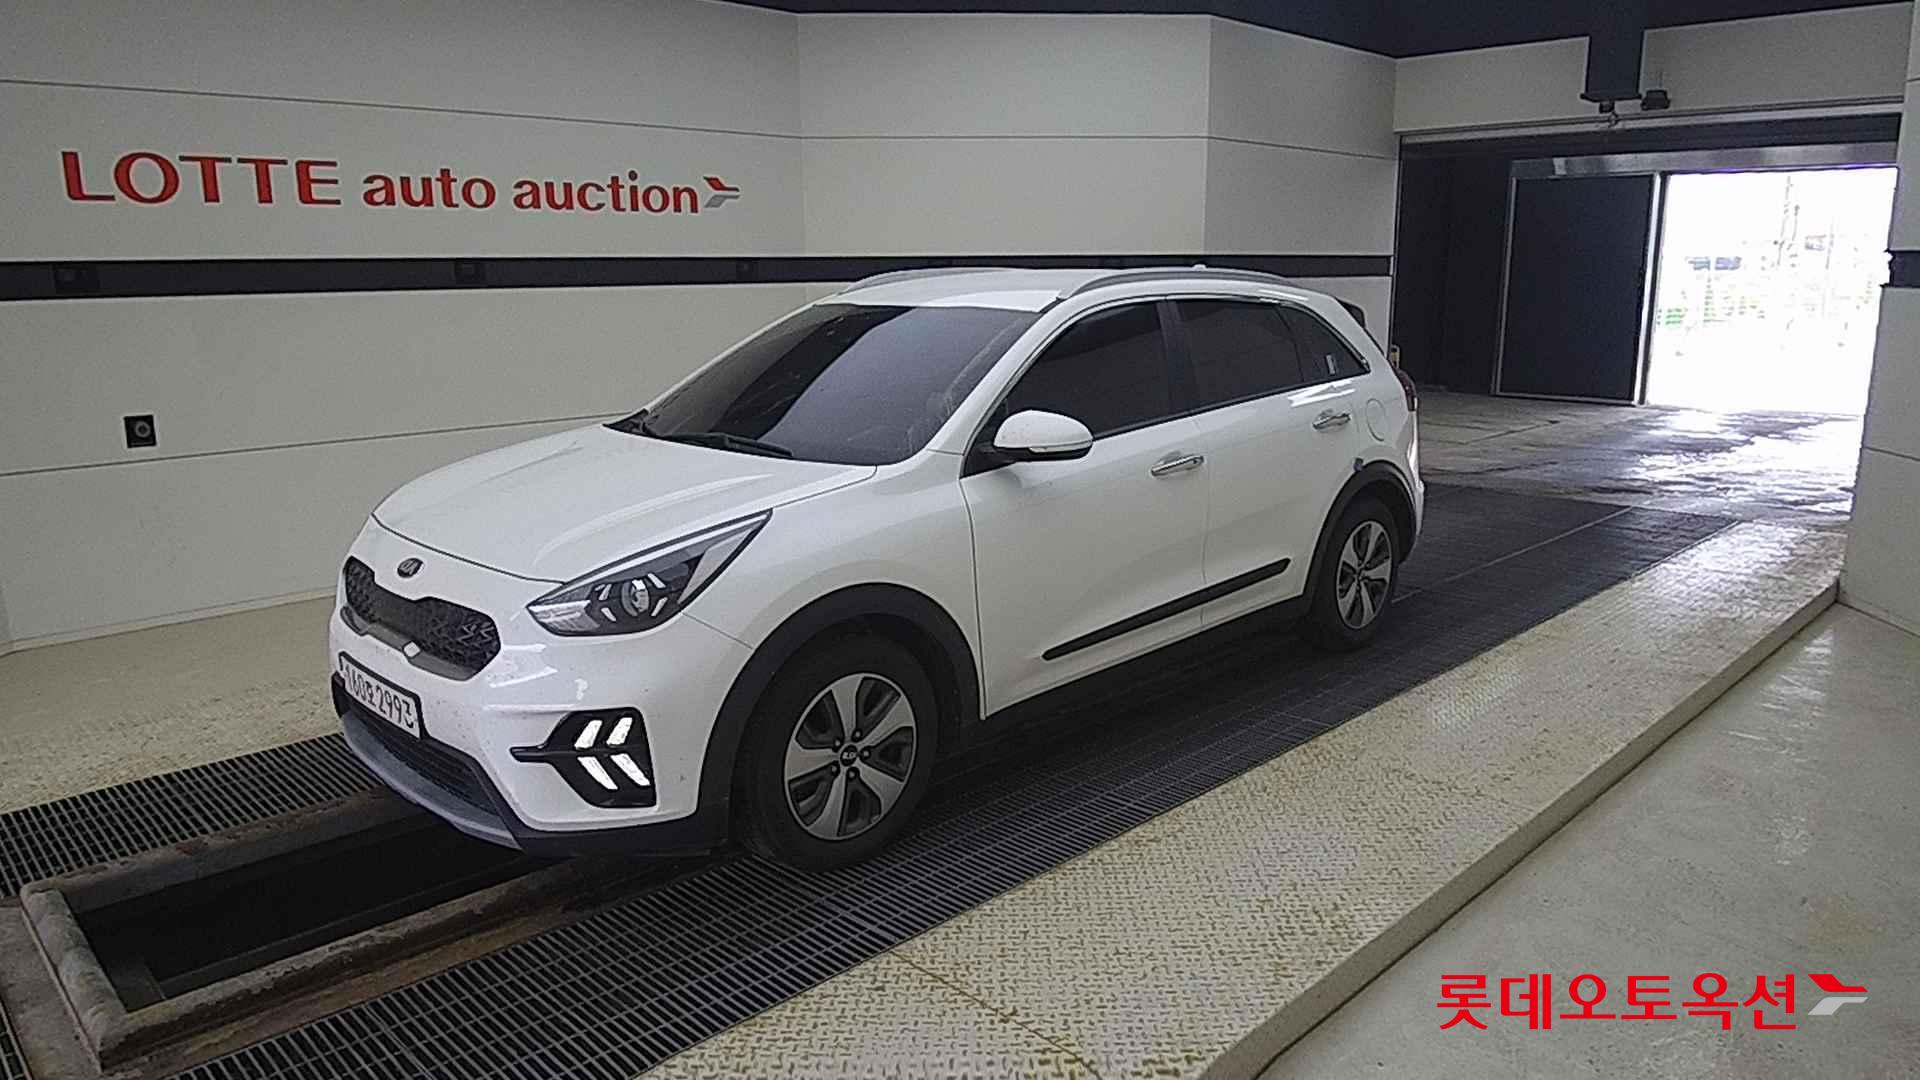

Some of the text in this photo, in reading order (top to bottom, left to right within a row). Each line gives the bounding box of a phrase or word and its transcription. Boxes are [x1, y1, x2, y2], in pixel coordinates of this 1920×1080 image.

[62, 151, 700, 213] LOTTE auto auction
